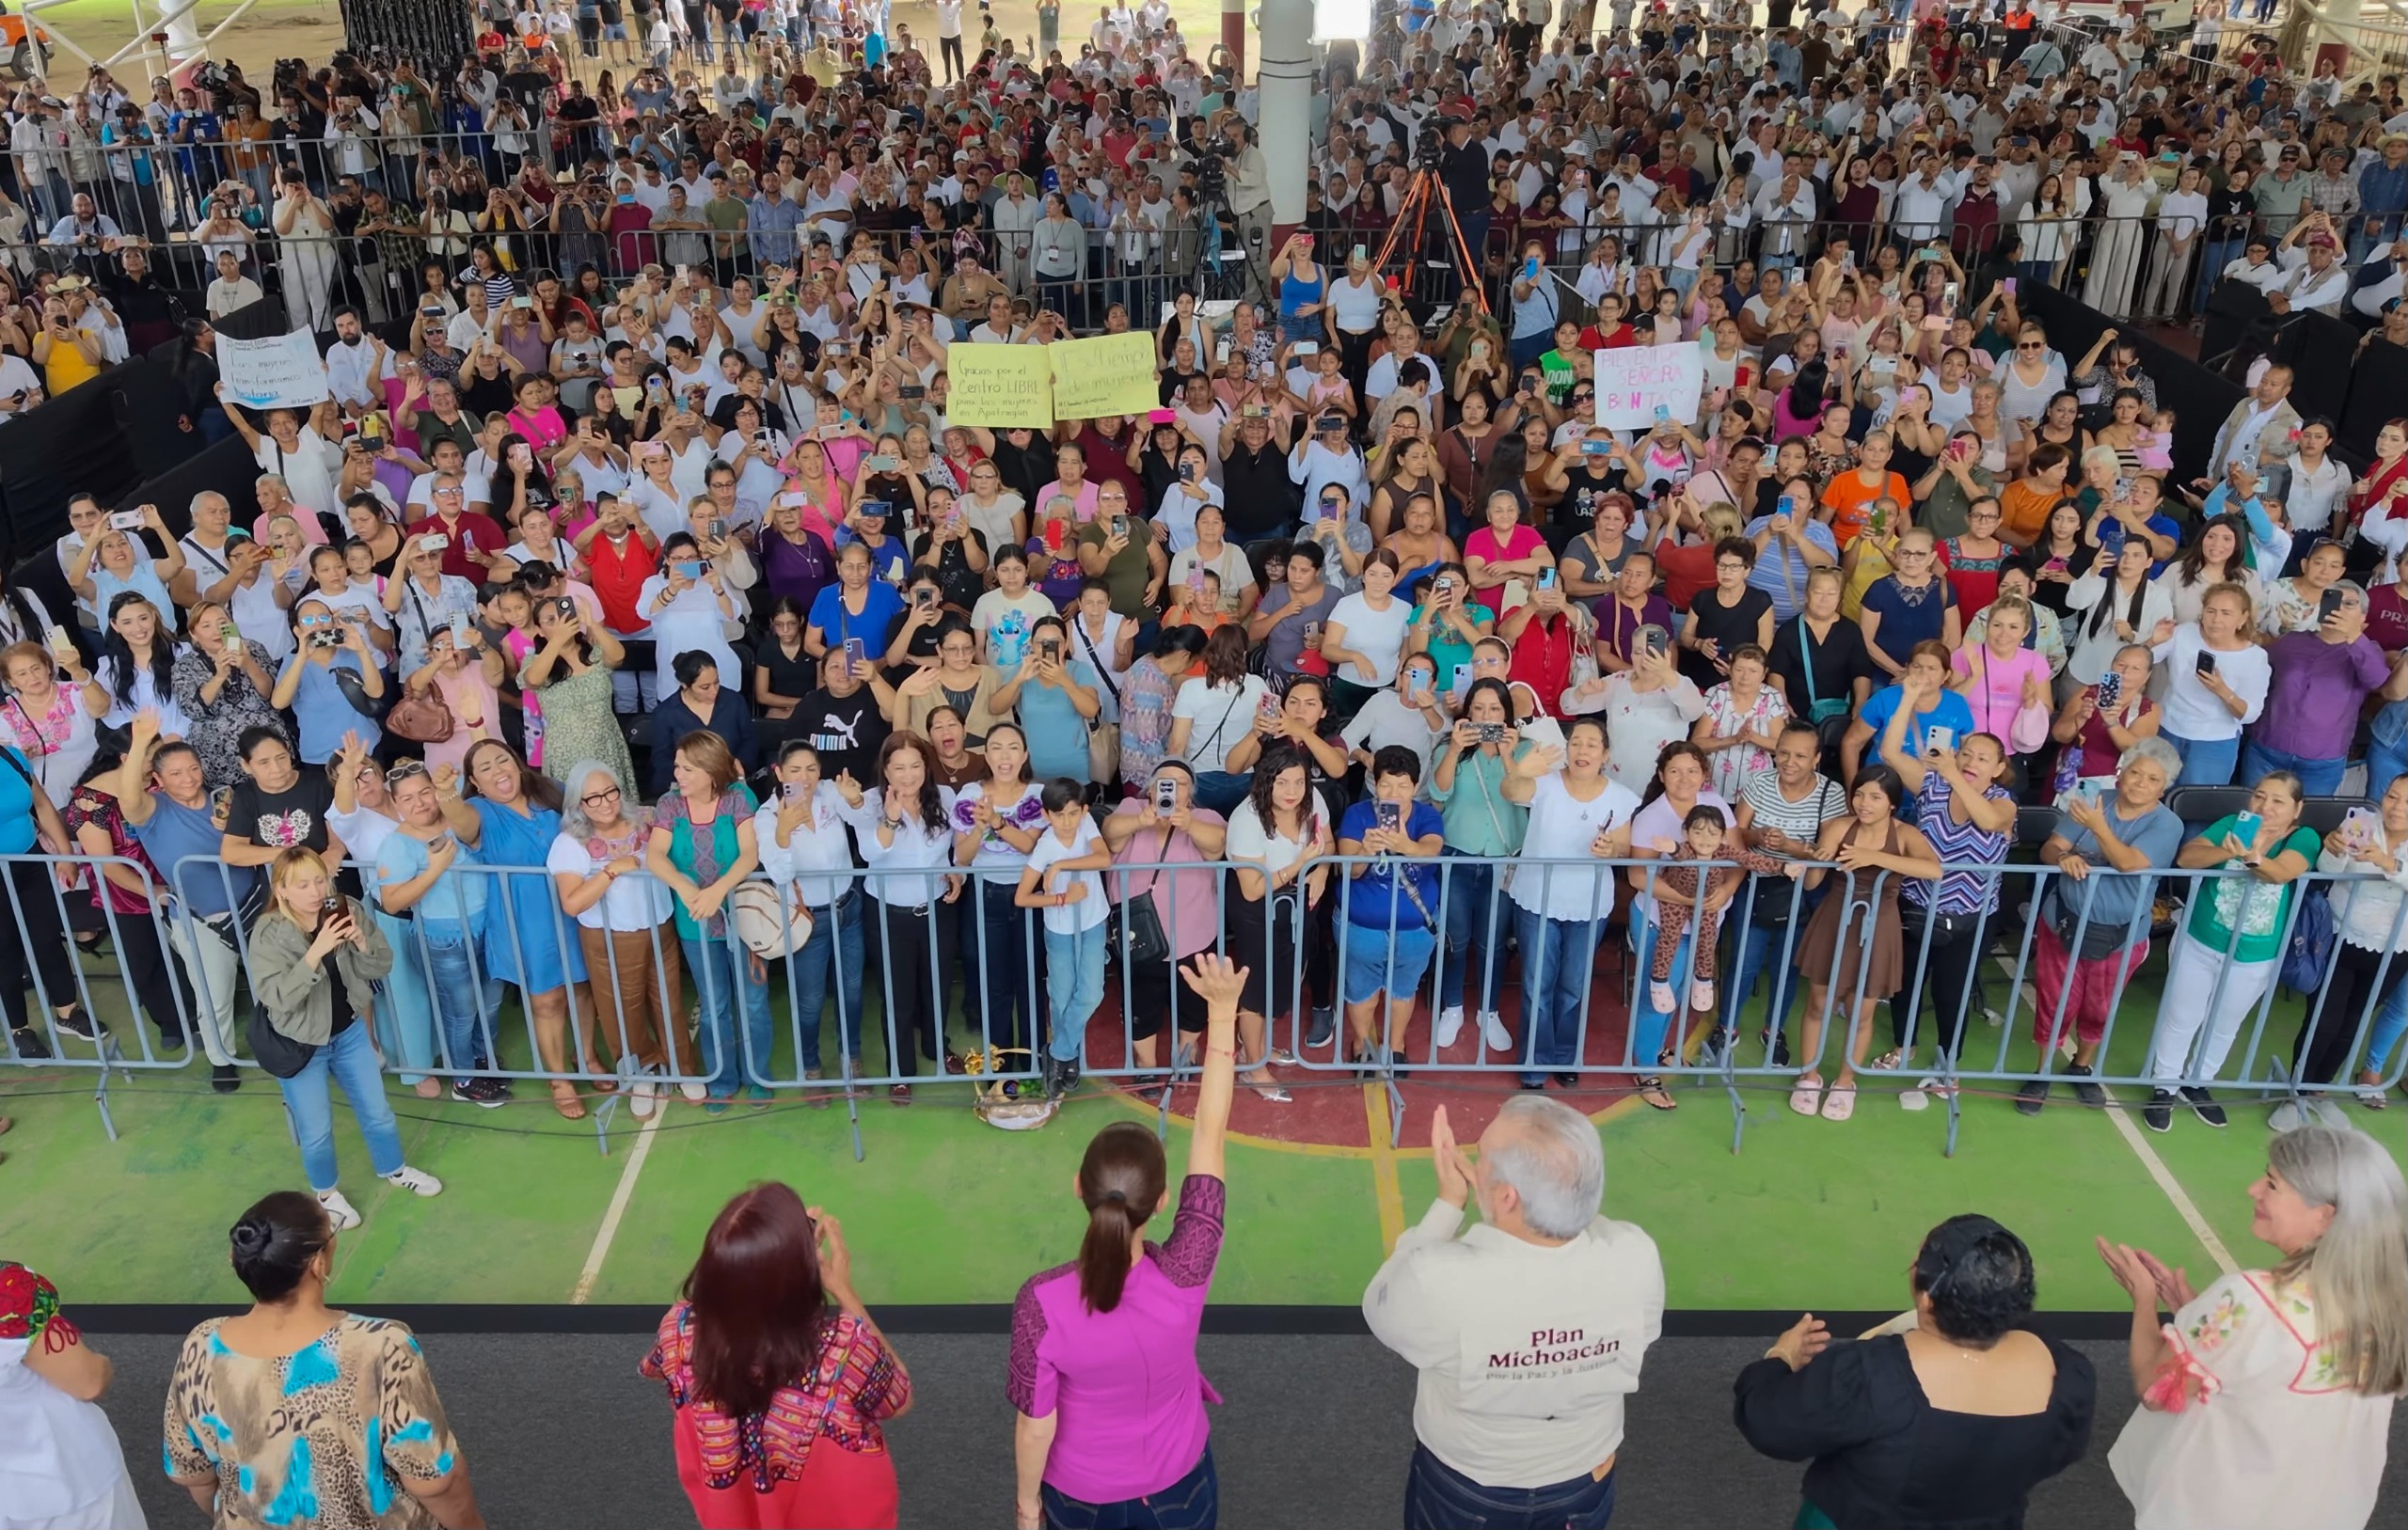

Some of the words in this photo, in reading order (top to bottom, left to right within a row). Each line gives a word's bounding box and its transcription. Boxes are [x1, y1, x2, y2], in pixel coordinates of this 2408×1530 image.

[958, 356, 992, 377] Gracias
[996, 368, 1012, 380] por
[1017, 364, 1026, 375] el
[958, 378, 1002, 394] Centro
[809, 733, 848, 751] PUMA
[1530, 1328, 1584, 1348] Plan
[1487, 1336, 1621, 1369] Michoacán
[1512, 1371, 1523, 1380] la
[1527, 1370, 1548, 1380] Paz
[1550, 1369, 1559, 1380] y
[1561, 1366, 1573, 1376] la
